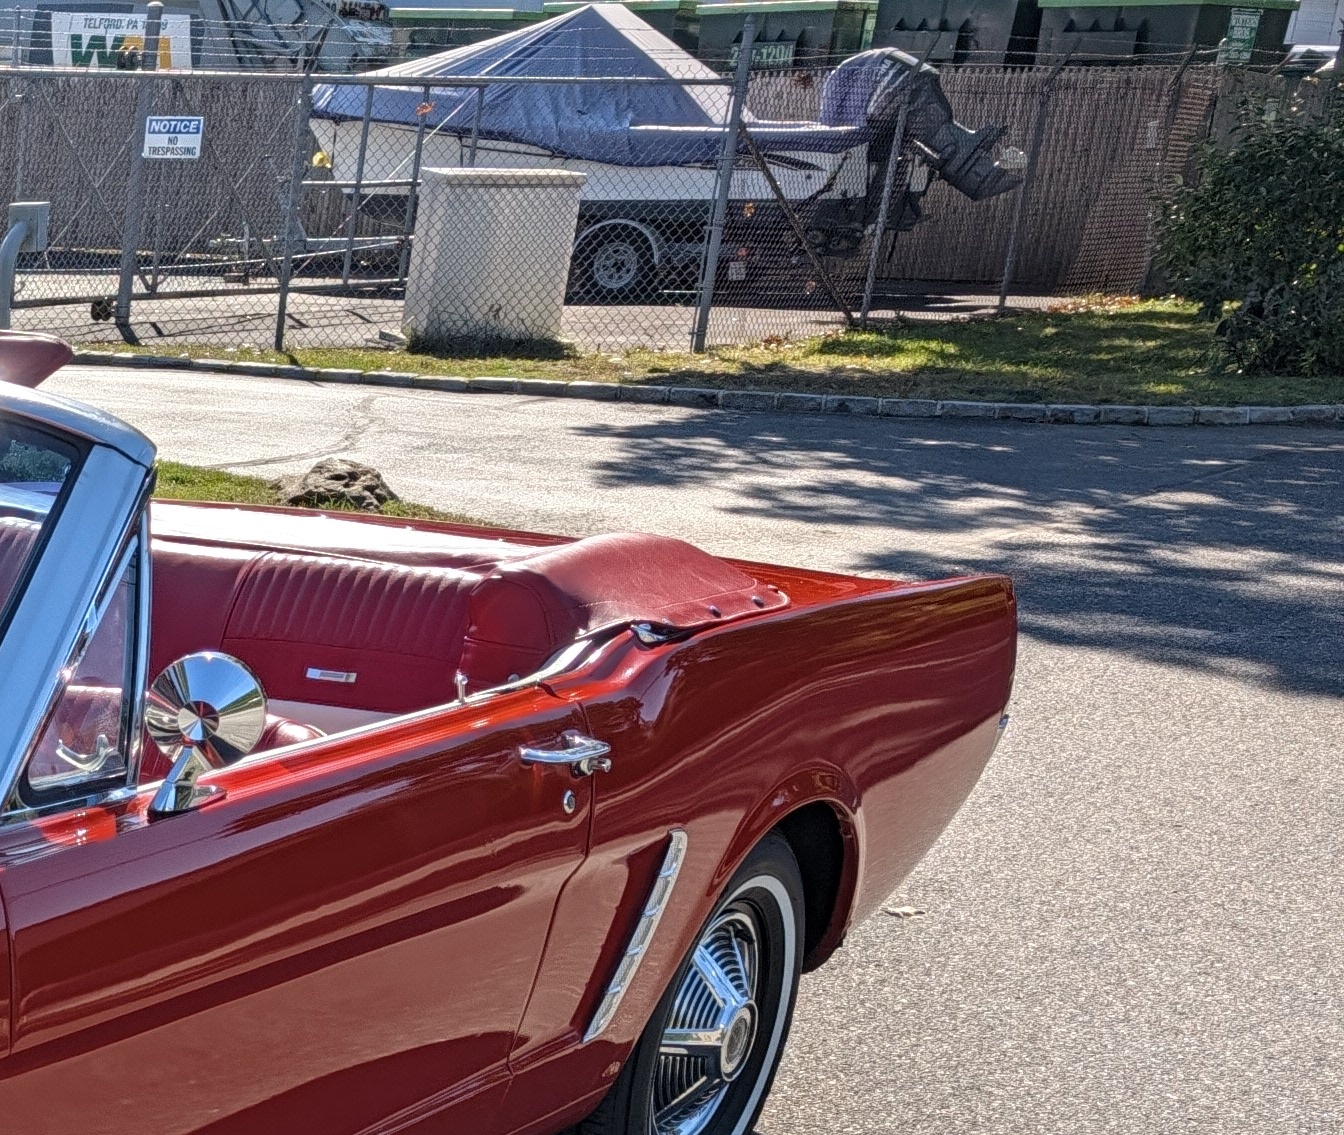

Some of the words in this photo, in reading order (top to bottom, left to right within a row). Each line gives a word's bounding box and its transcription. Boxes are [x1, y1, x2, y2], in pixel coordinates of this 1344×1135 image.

[126, 18, 139, 30] PA
[150, 120, 199, 133] NOTICE
[168, 135, 179, 146] NO
[148, 146, 197, 156] TRESPASSING
